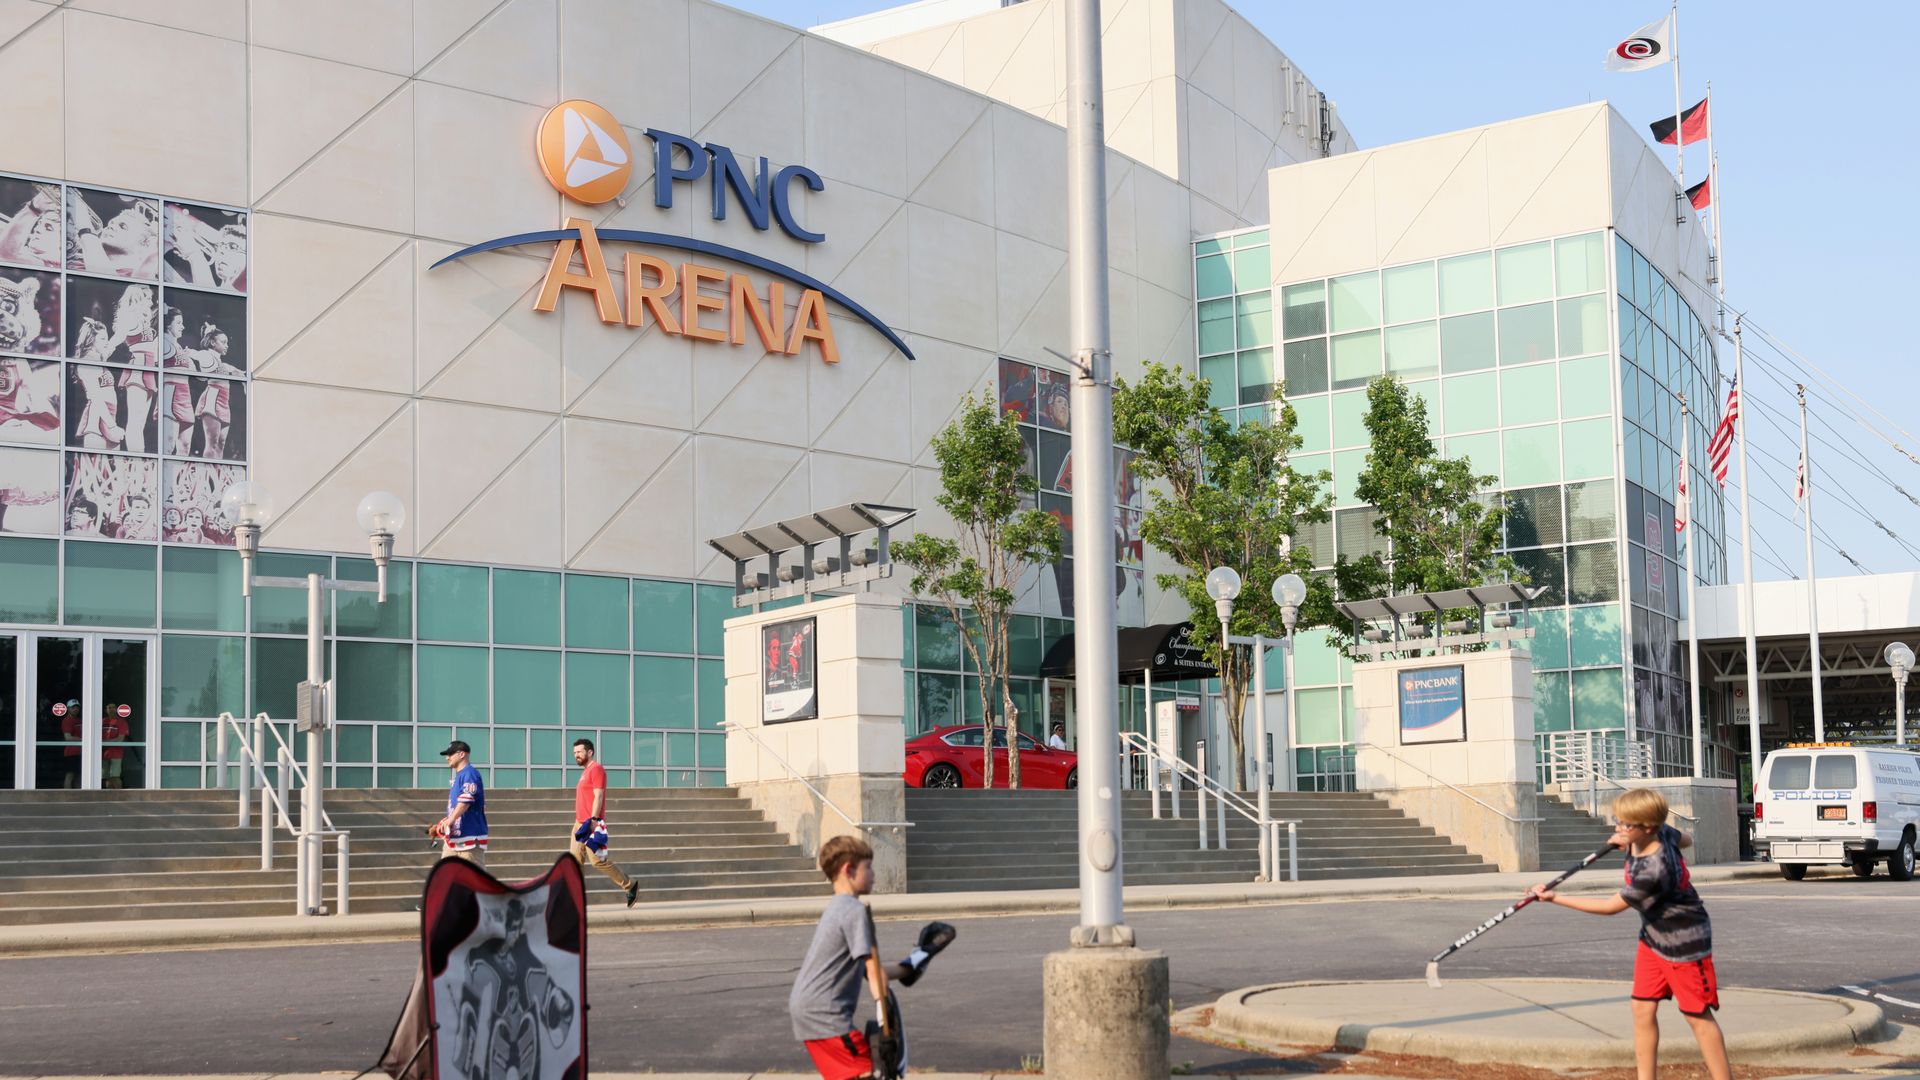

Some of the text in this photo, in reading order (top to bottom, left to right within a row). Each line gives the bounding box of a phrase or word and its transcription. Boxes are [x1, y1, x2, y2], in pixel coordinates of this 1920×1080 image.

[643, 127, 825, 243] PNC
[533, 217, 840, 364] ARENA
[1179, 659, 1194, 667] SUITES
[1773, 791, 1852, 801] POLICE
[1455, 906, 1515, 948] EASTON
